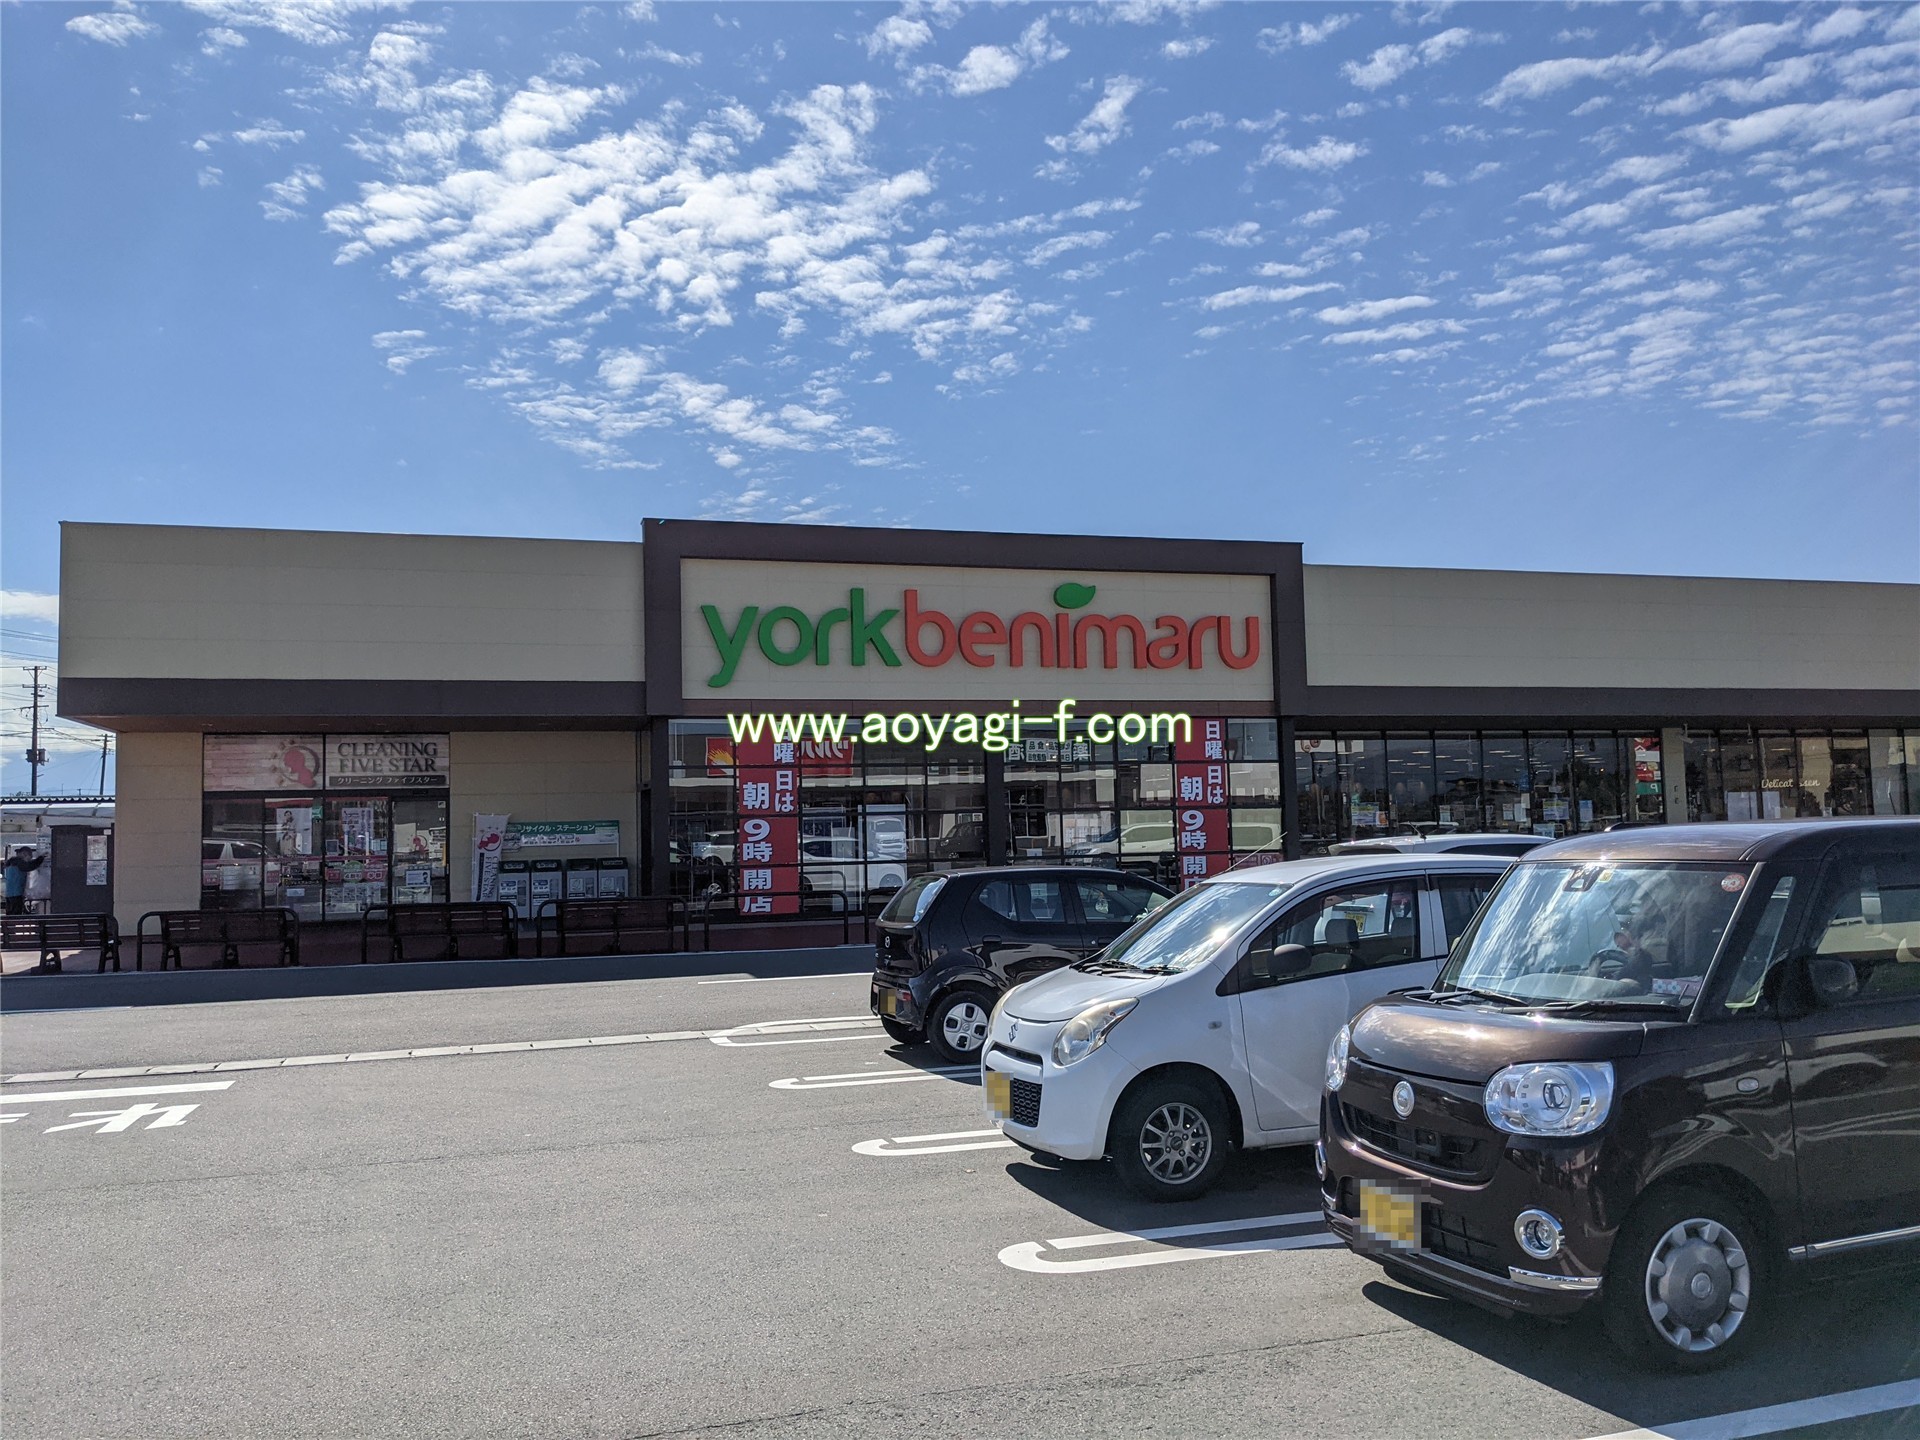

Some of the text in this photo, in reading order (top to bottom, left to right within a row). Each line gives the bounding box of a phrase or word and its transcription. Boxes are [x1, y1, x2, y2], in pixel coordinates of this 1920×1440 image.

[700, 583, 1260, 688] yorkbenimaru
[337, 741, 439, 757] CLEANING
[339, 757, 437, 773] FIVE STAR
[1204, 720, 1225, 805] 日曜日は
